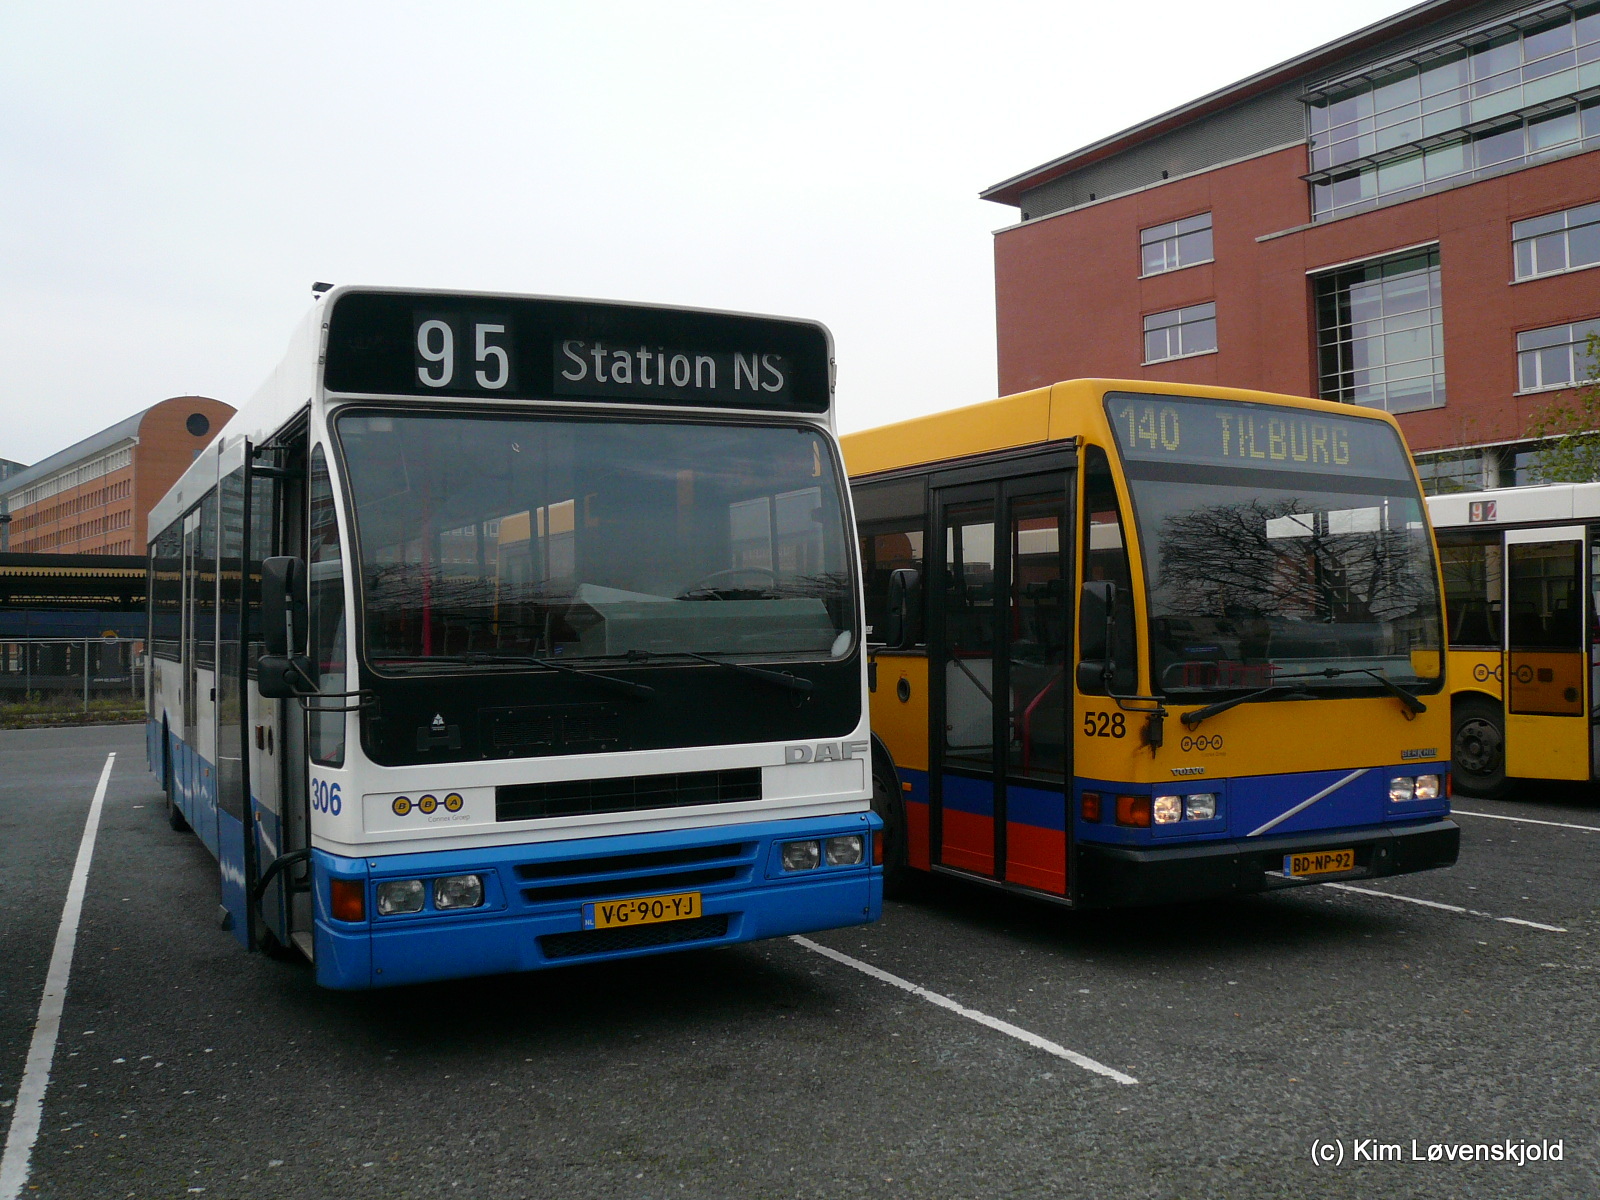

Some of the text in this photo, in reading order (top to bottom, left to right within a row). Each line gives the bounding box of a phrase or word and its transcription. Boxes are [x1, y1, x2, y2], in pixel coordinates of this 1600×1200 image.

[417, 319, 784, 392] 95 Station NS
[1119, 402, 1350, 465] 140 TILBURG
[1471, 501, 1497, 522] 92
[1084, 711, 1126, 738] 528
[785, 740, 868, 764] DAF
[1171, 767, 1205, 776] VOLVO
[312, 777, 342, 816] 306
[1293, 853, 1351, 873] BD-NP-92
[585, 918, 594, 926] NL
